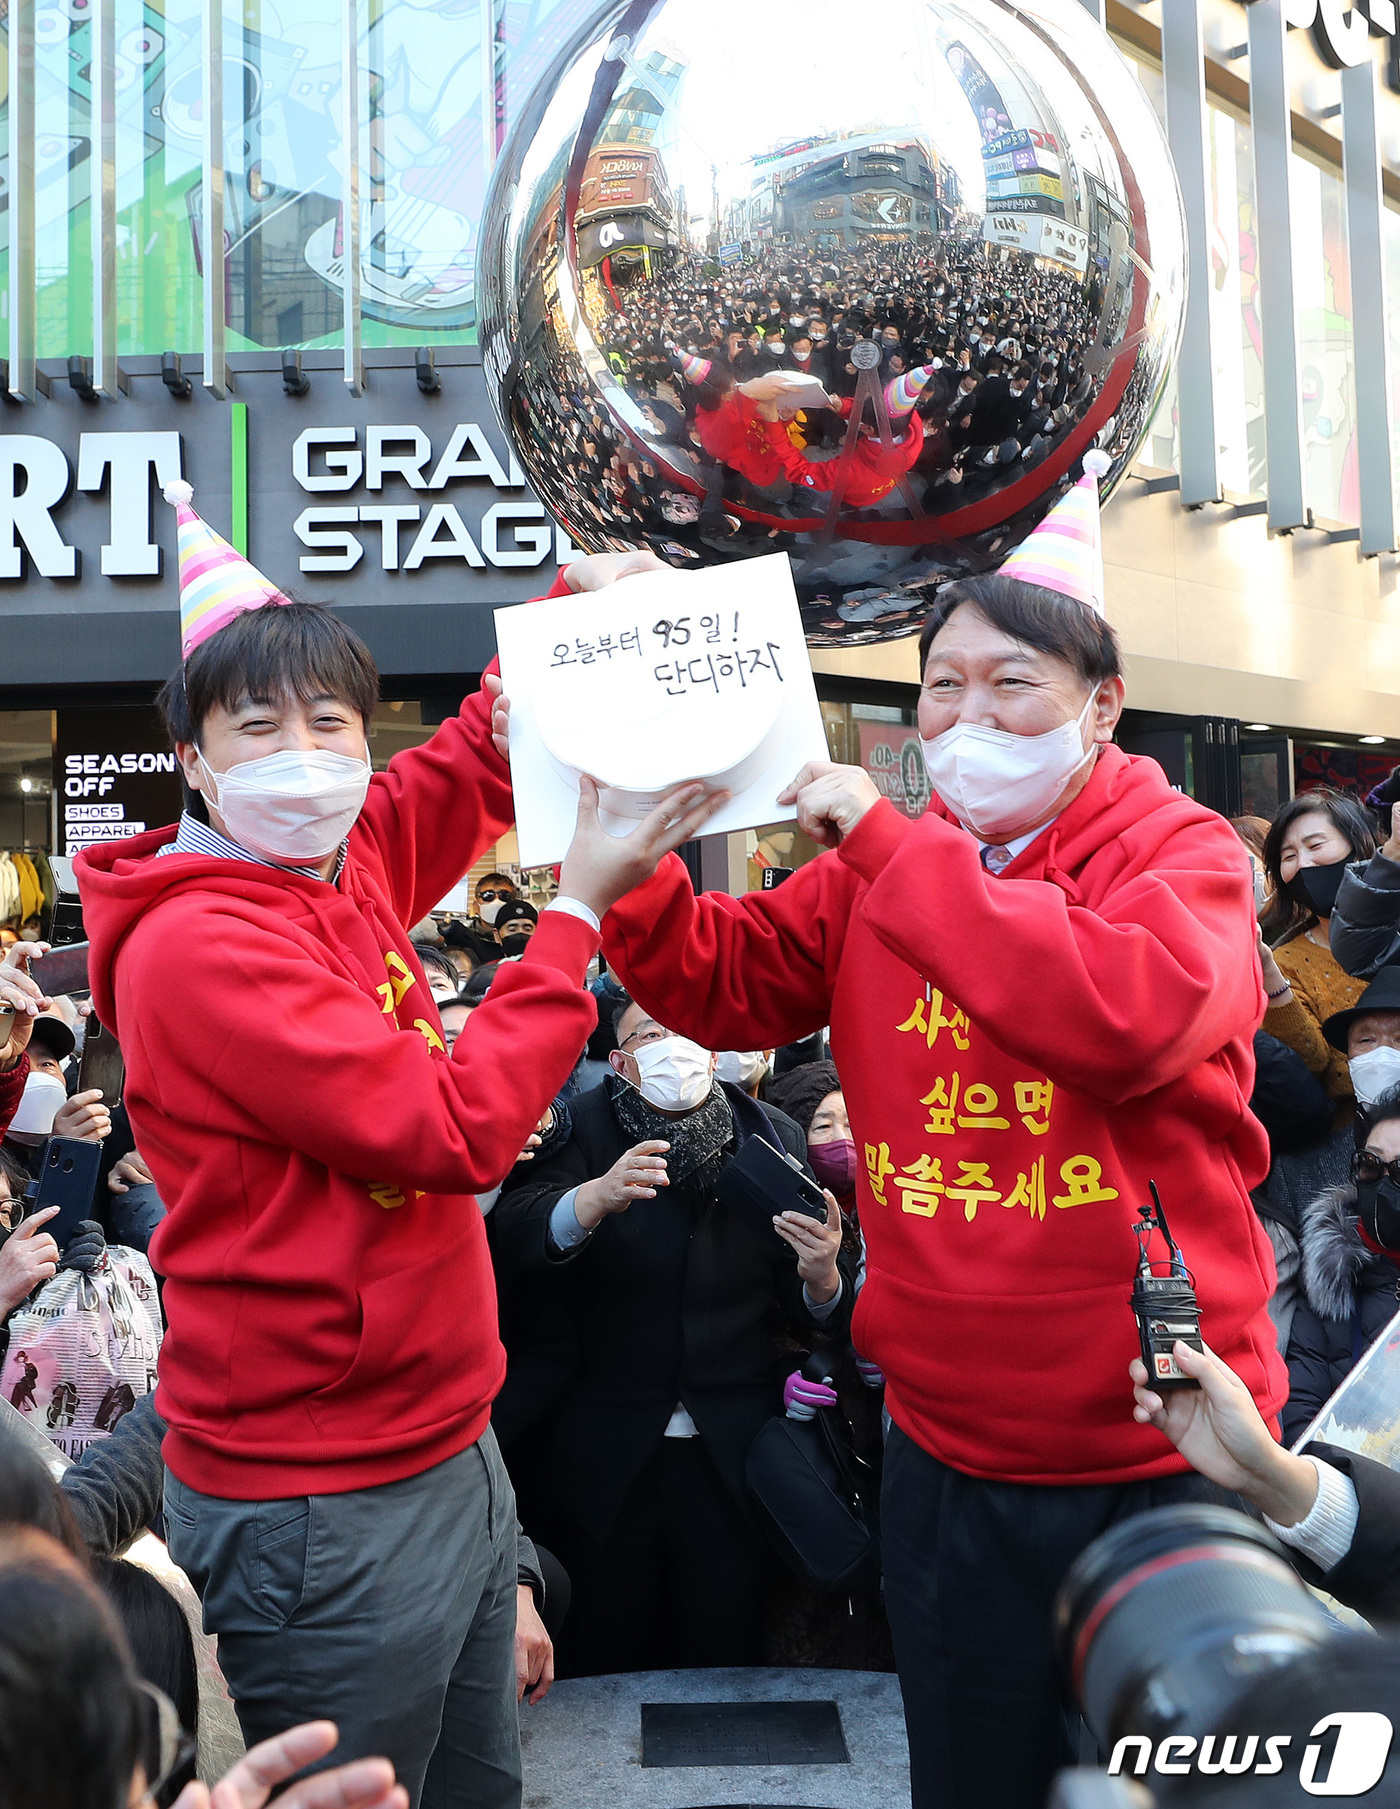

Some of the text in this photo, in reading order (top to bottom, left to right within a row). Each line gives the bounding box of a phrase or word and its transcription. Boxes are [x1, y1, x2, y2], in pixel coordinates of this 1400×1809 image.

[292, 424, 525, 492] GRA
[549, 626, 644, 668] 오늘부터
[653, 641, 785, 696] 단디하자
[65, 752, 176, 775] SEASON
[64, 776, 115, 798] OFF
[68, 806, 120, 819] SHOES
[68, 824, 141, 837] APPAREL
[918, 1070, 1055, 1136] 싶으면
[863, 1140, 1120, 1223] 말씀주세요
